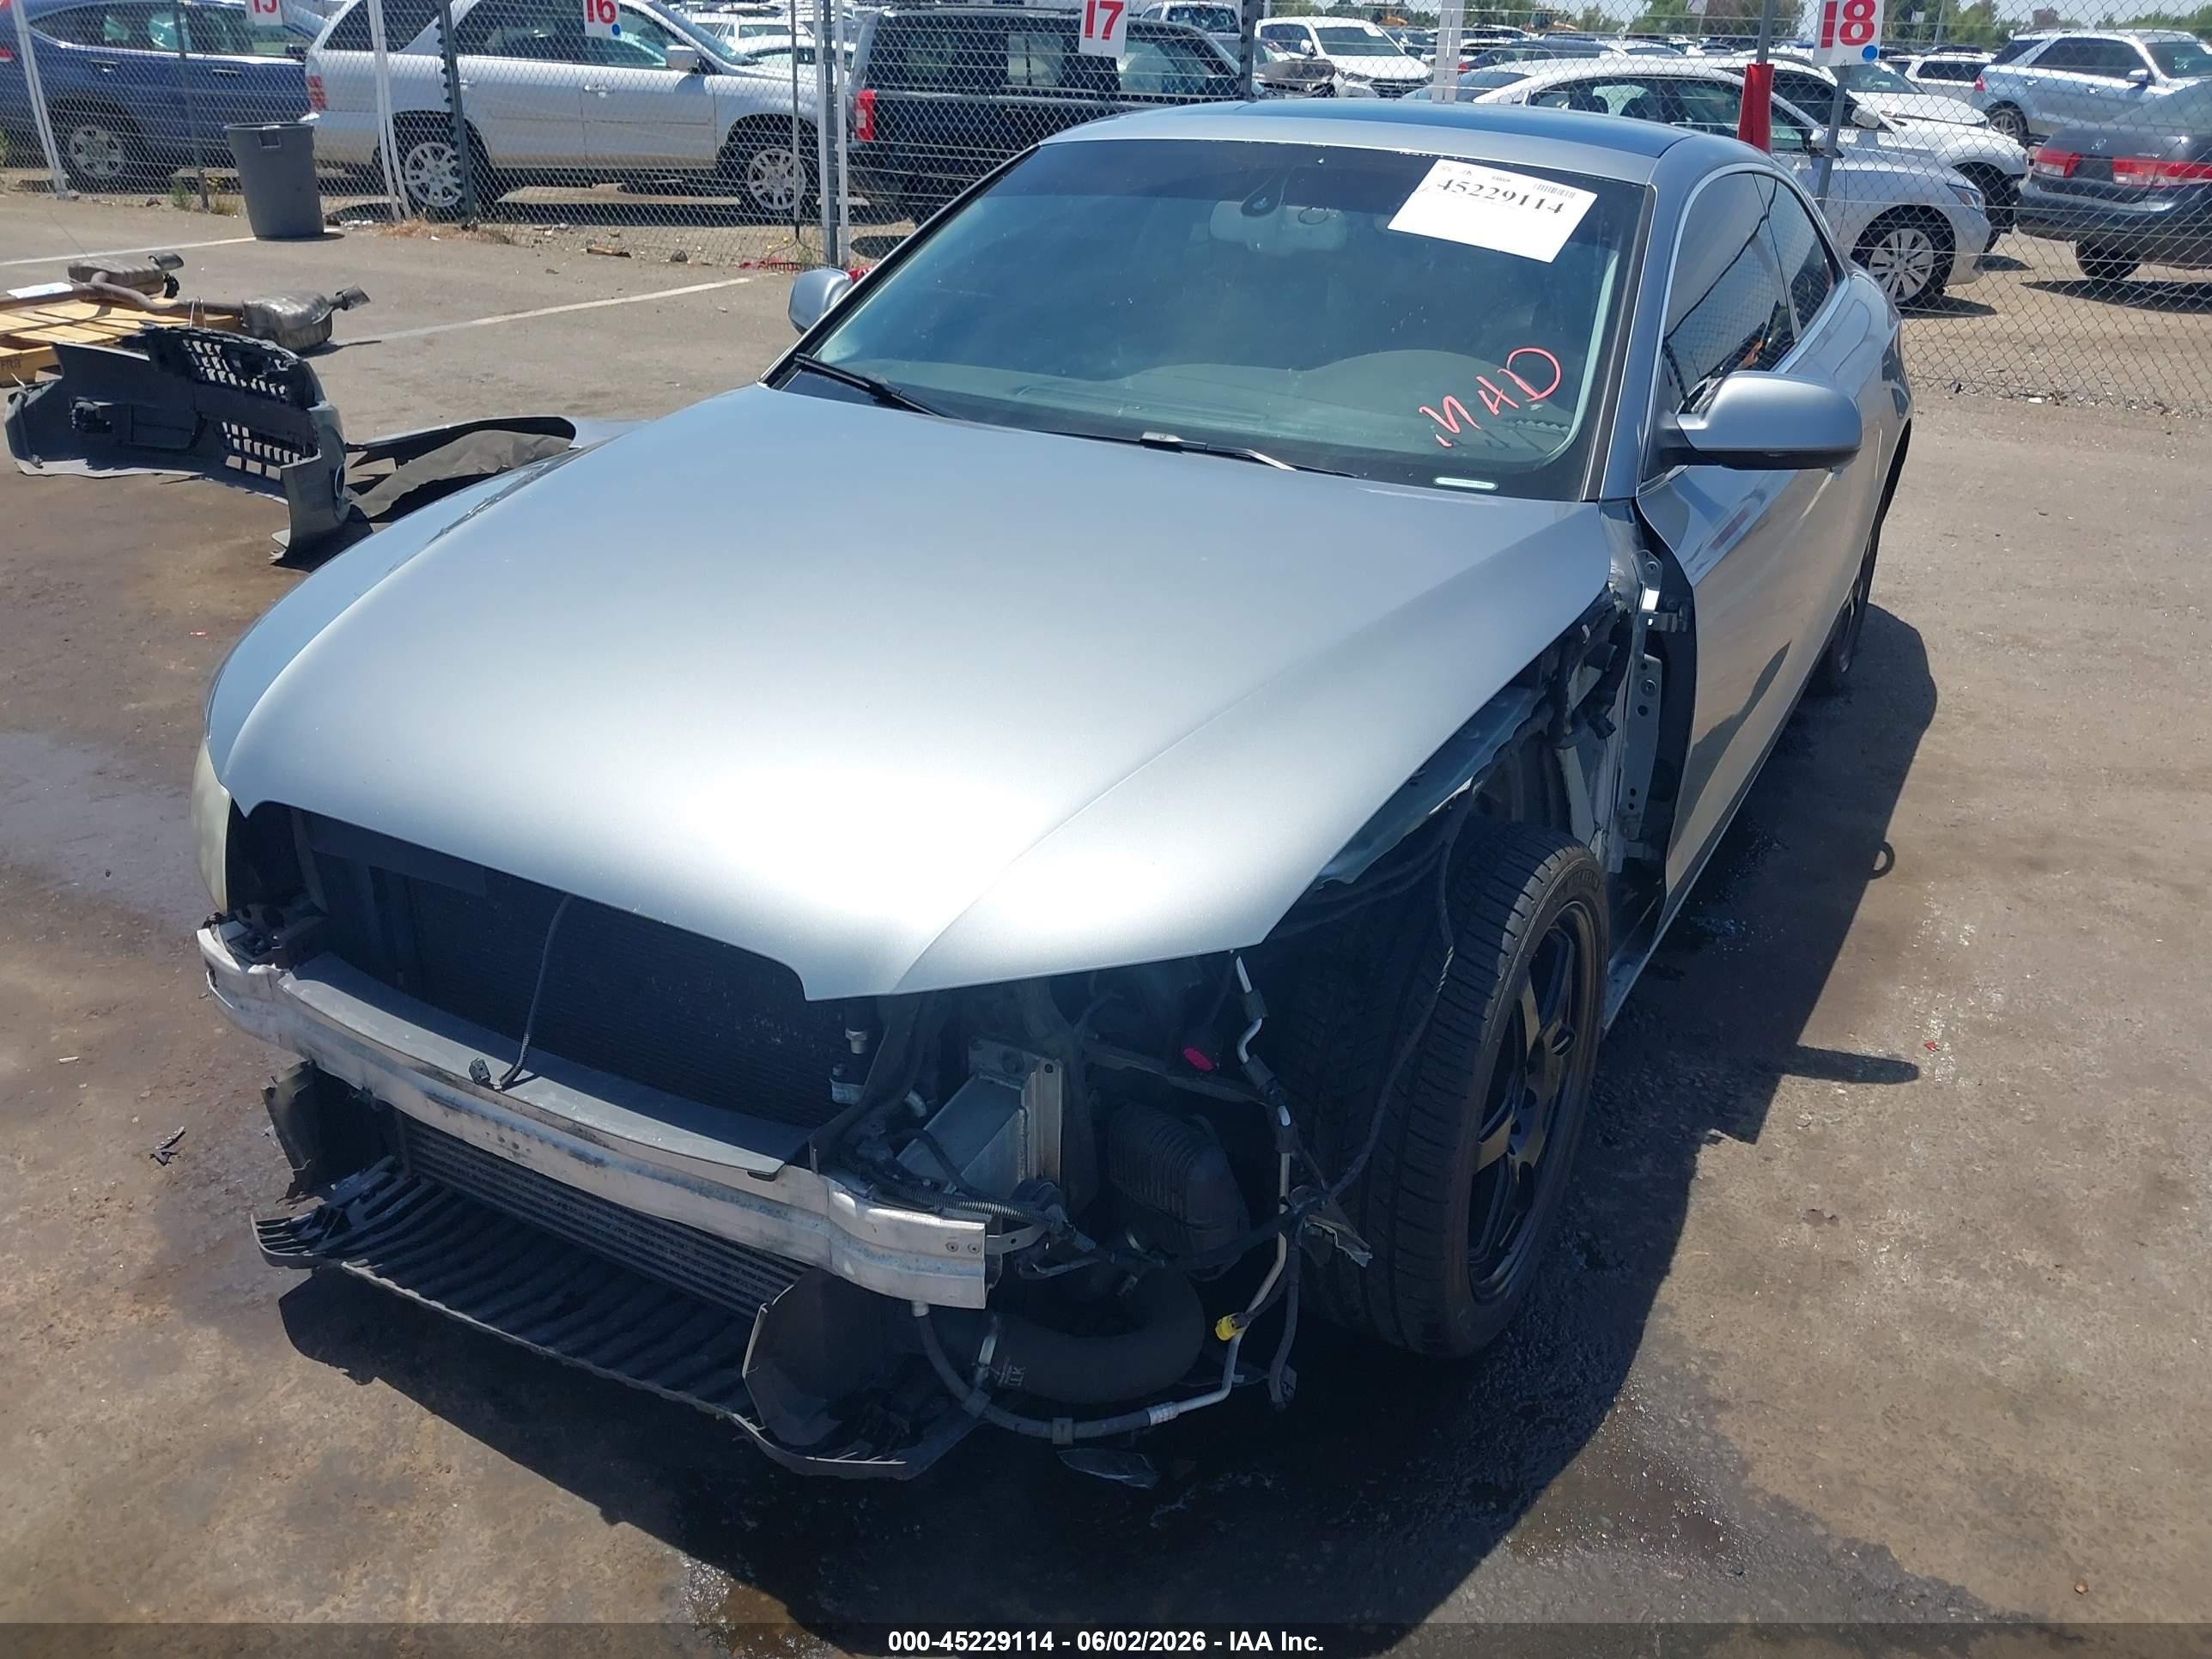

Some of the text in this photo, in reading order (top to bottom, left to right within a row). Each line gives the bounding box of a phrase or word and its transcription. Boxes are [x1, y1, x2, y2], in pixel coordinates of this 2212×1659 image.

[586, 0, 617, 24] 16
[1084, 0, 1124, 40] 17
[1820, 0, 1875, 48] 18
[1436, 179, 1565, 214] 45229114
